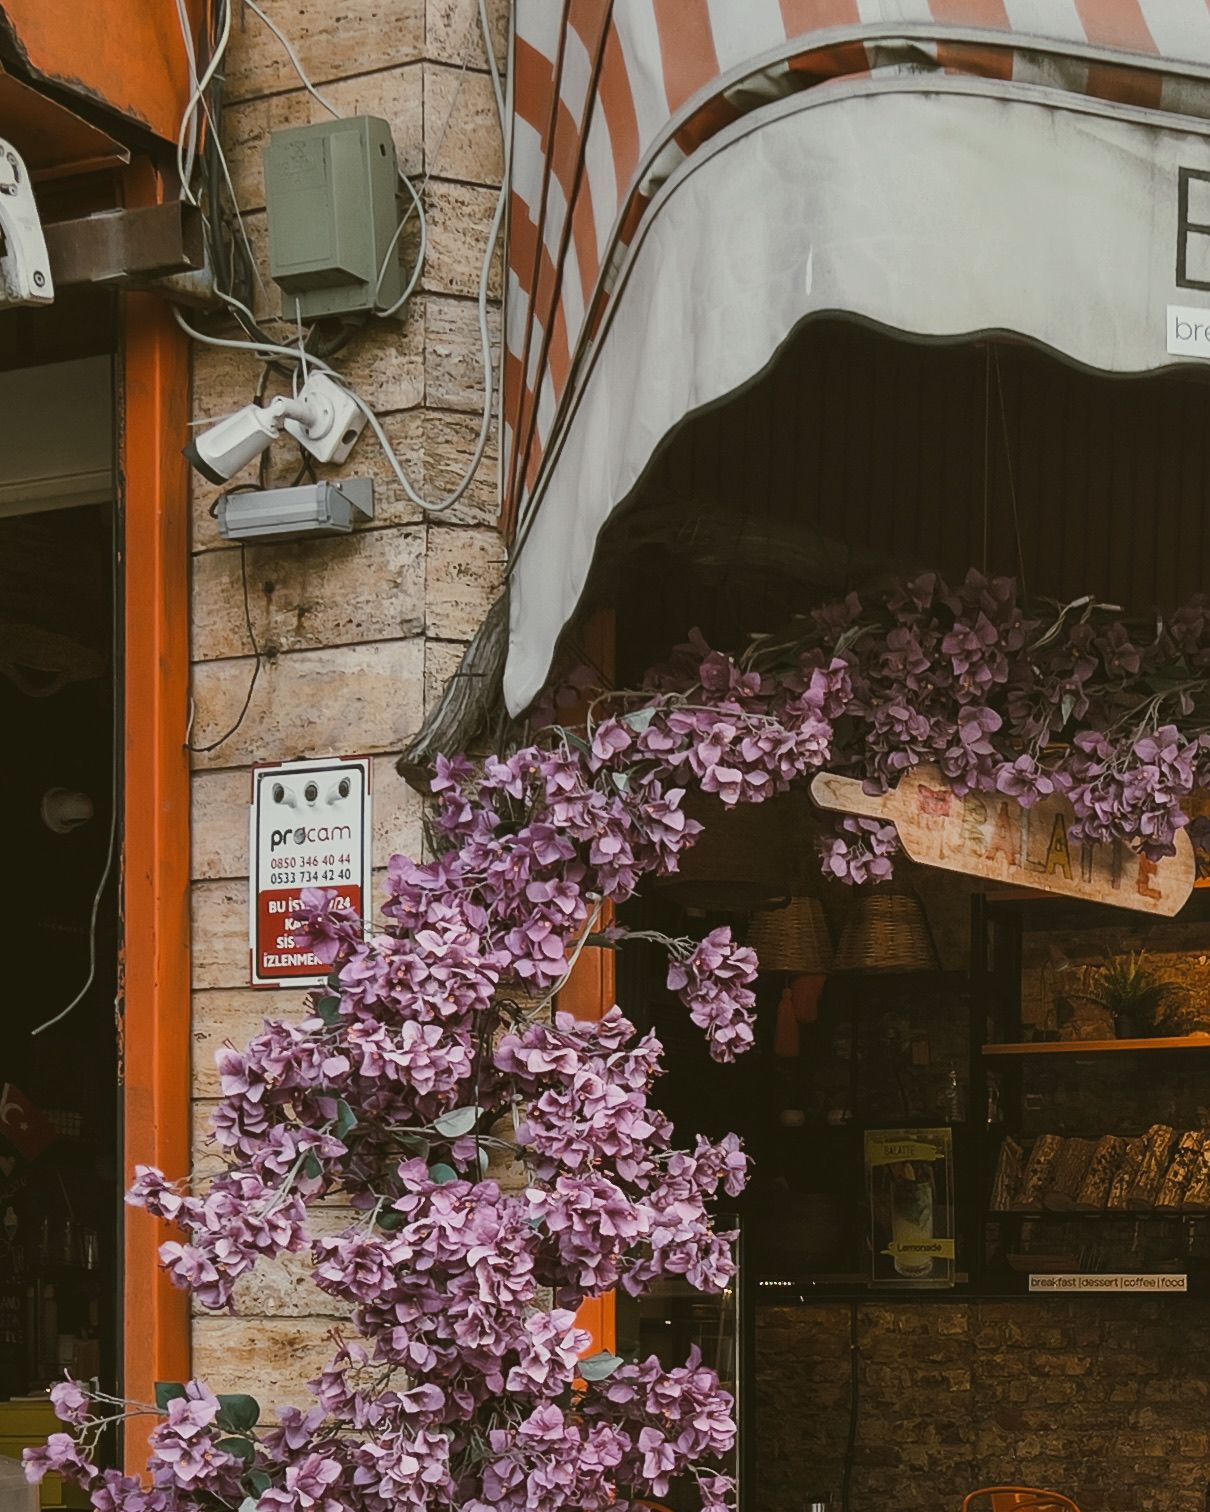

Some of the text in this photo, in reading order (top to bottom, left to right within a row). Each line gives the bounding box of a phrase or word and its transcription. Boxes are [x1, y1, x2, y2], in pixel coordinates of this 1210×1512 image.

[271, 825, 352, 852] procam
[271, 853, 351, 870] 0850 346 40 44
[270, 868, 351, 885] 0533 734 42 40
[268, 901, 286, 913] BU
[1030, 1277, 1185, 1288] breakfast dessert coffee food
